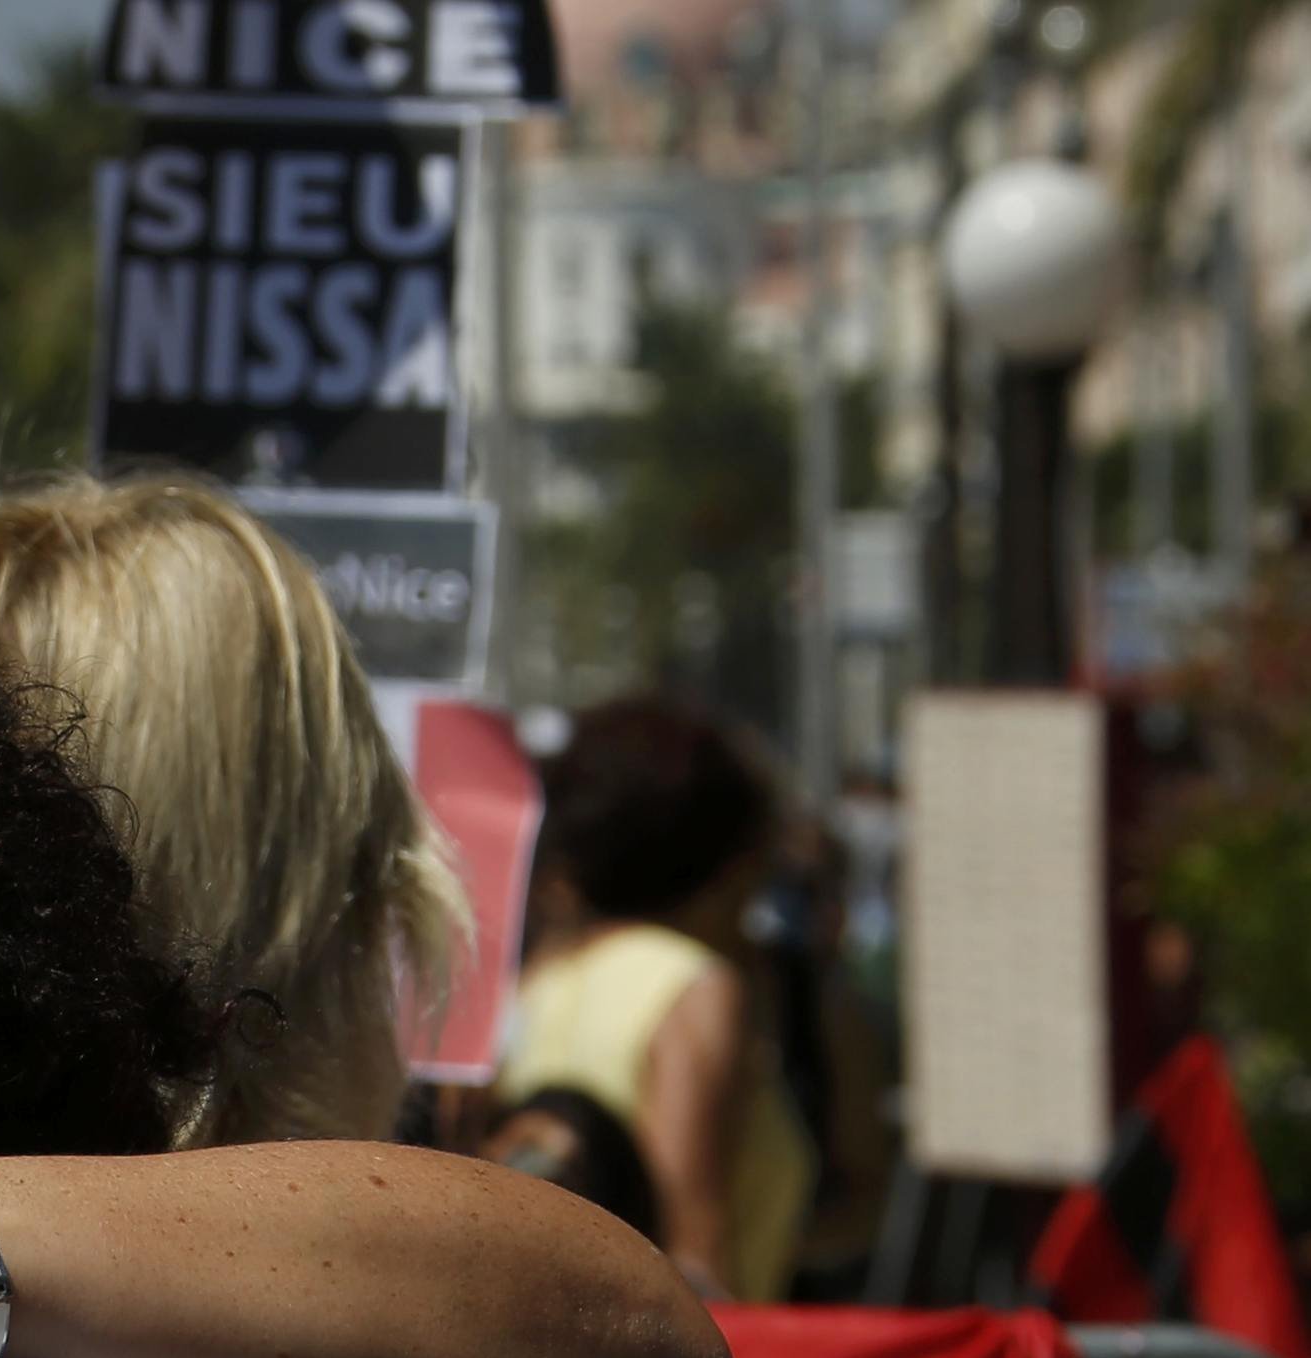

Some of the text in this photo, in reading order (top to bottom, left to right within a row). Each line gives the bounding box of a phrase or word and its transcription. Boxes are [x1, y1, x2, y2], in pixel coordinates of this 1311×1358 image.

[116, 0, 522, 93] NICE
[127, 145, 457, 259] SIEU
[113, 256, 449, 408] NISSA
